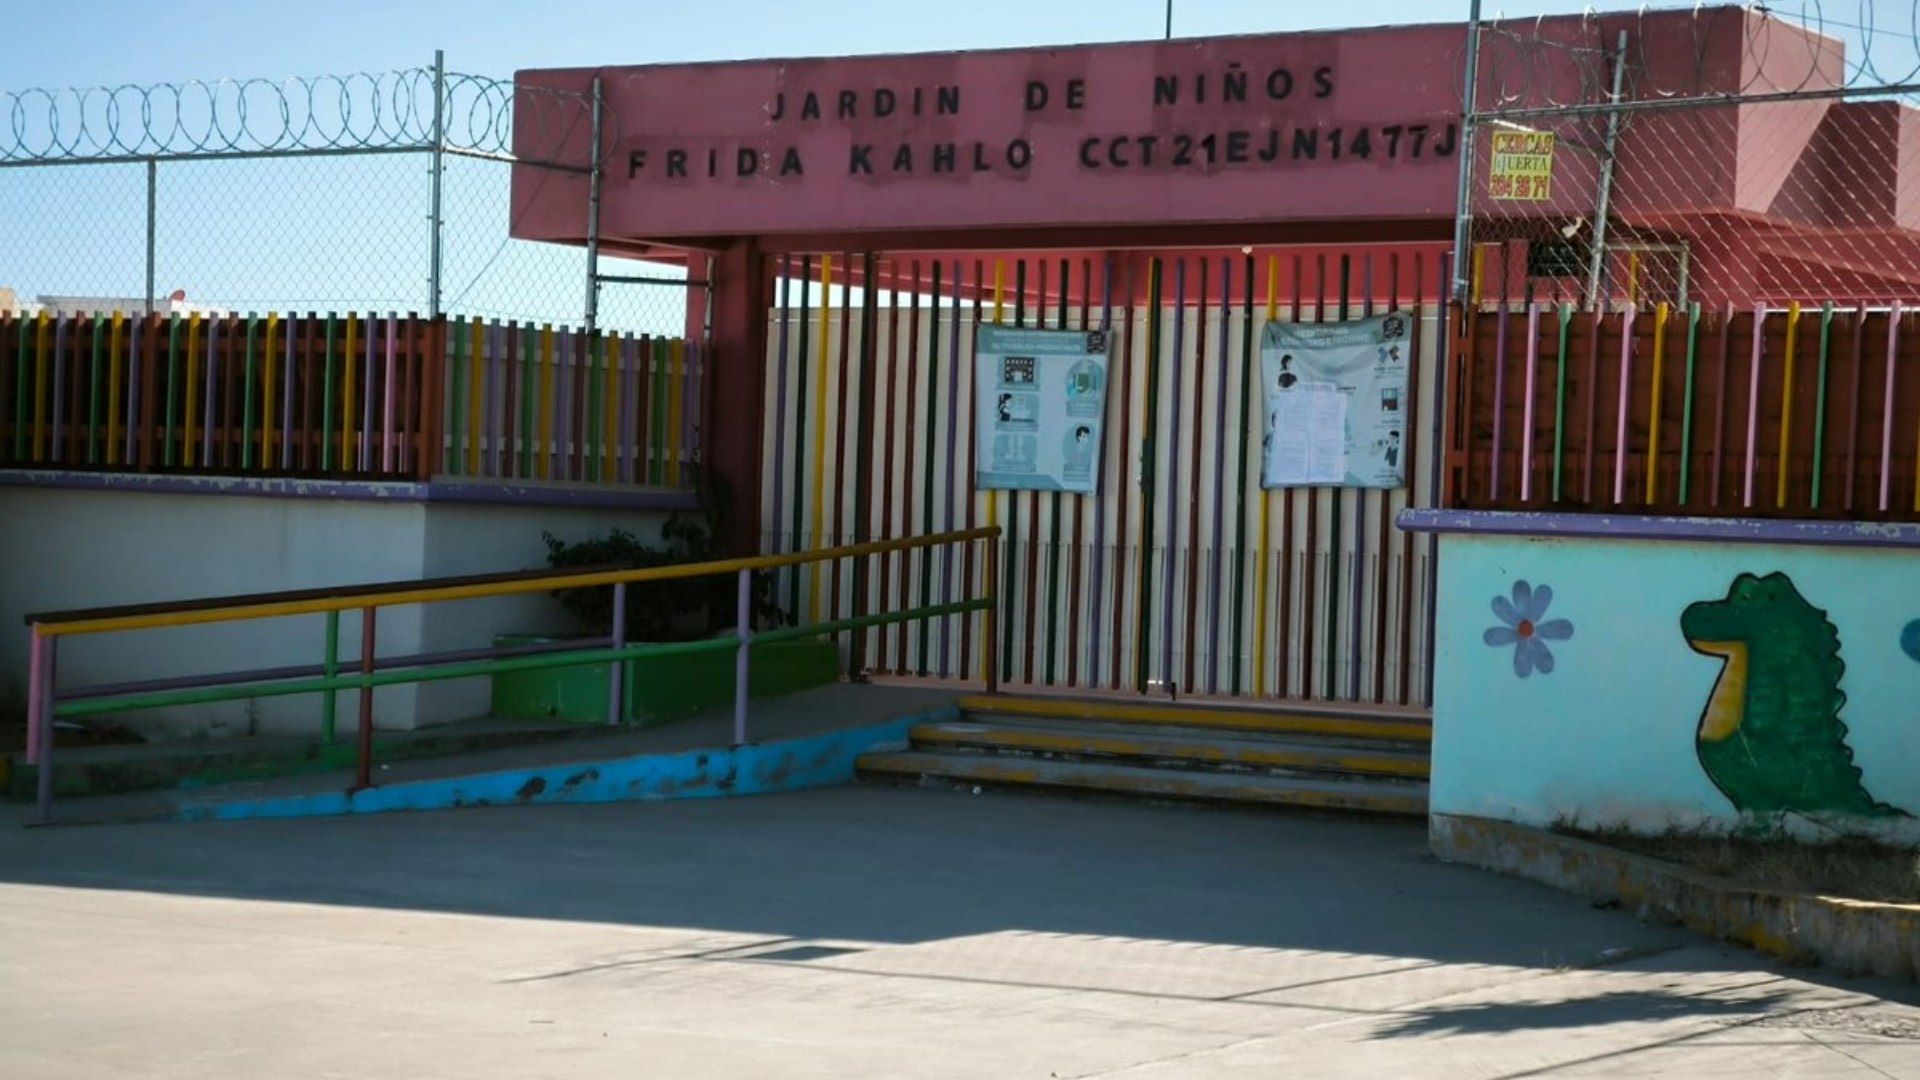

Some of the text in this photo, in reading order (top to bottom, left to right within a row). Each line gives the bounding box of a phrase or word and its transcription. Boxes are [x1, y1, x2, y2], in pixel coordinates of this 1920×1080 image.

[770, 63, 1334, 121] JARDIN DE NIÑOS
[628, 147, 803, 179] FRIDA
[850, 139, 1032, 174] KAHLO
[1079, 135, 1159, 168] CCT
[1495, 133, 1553, 154] CERCAS
